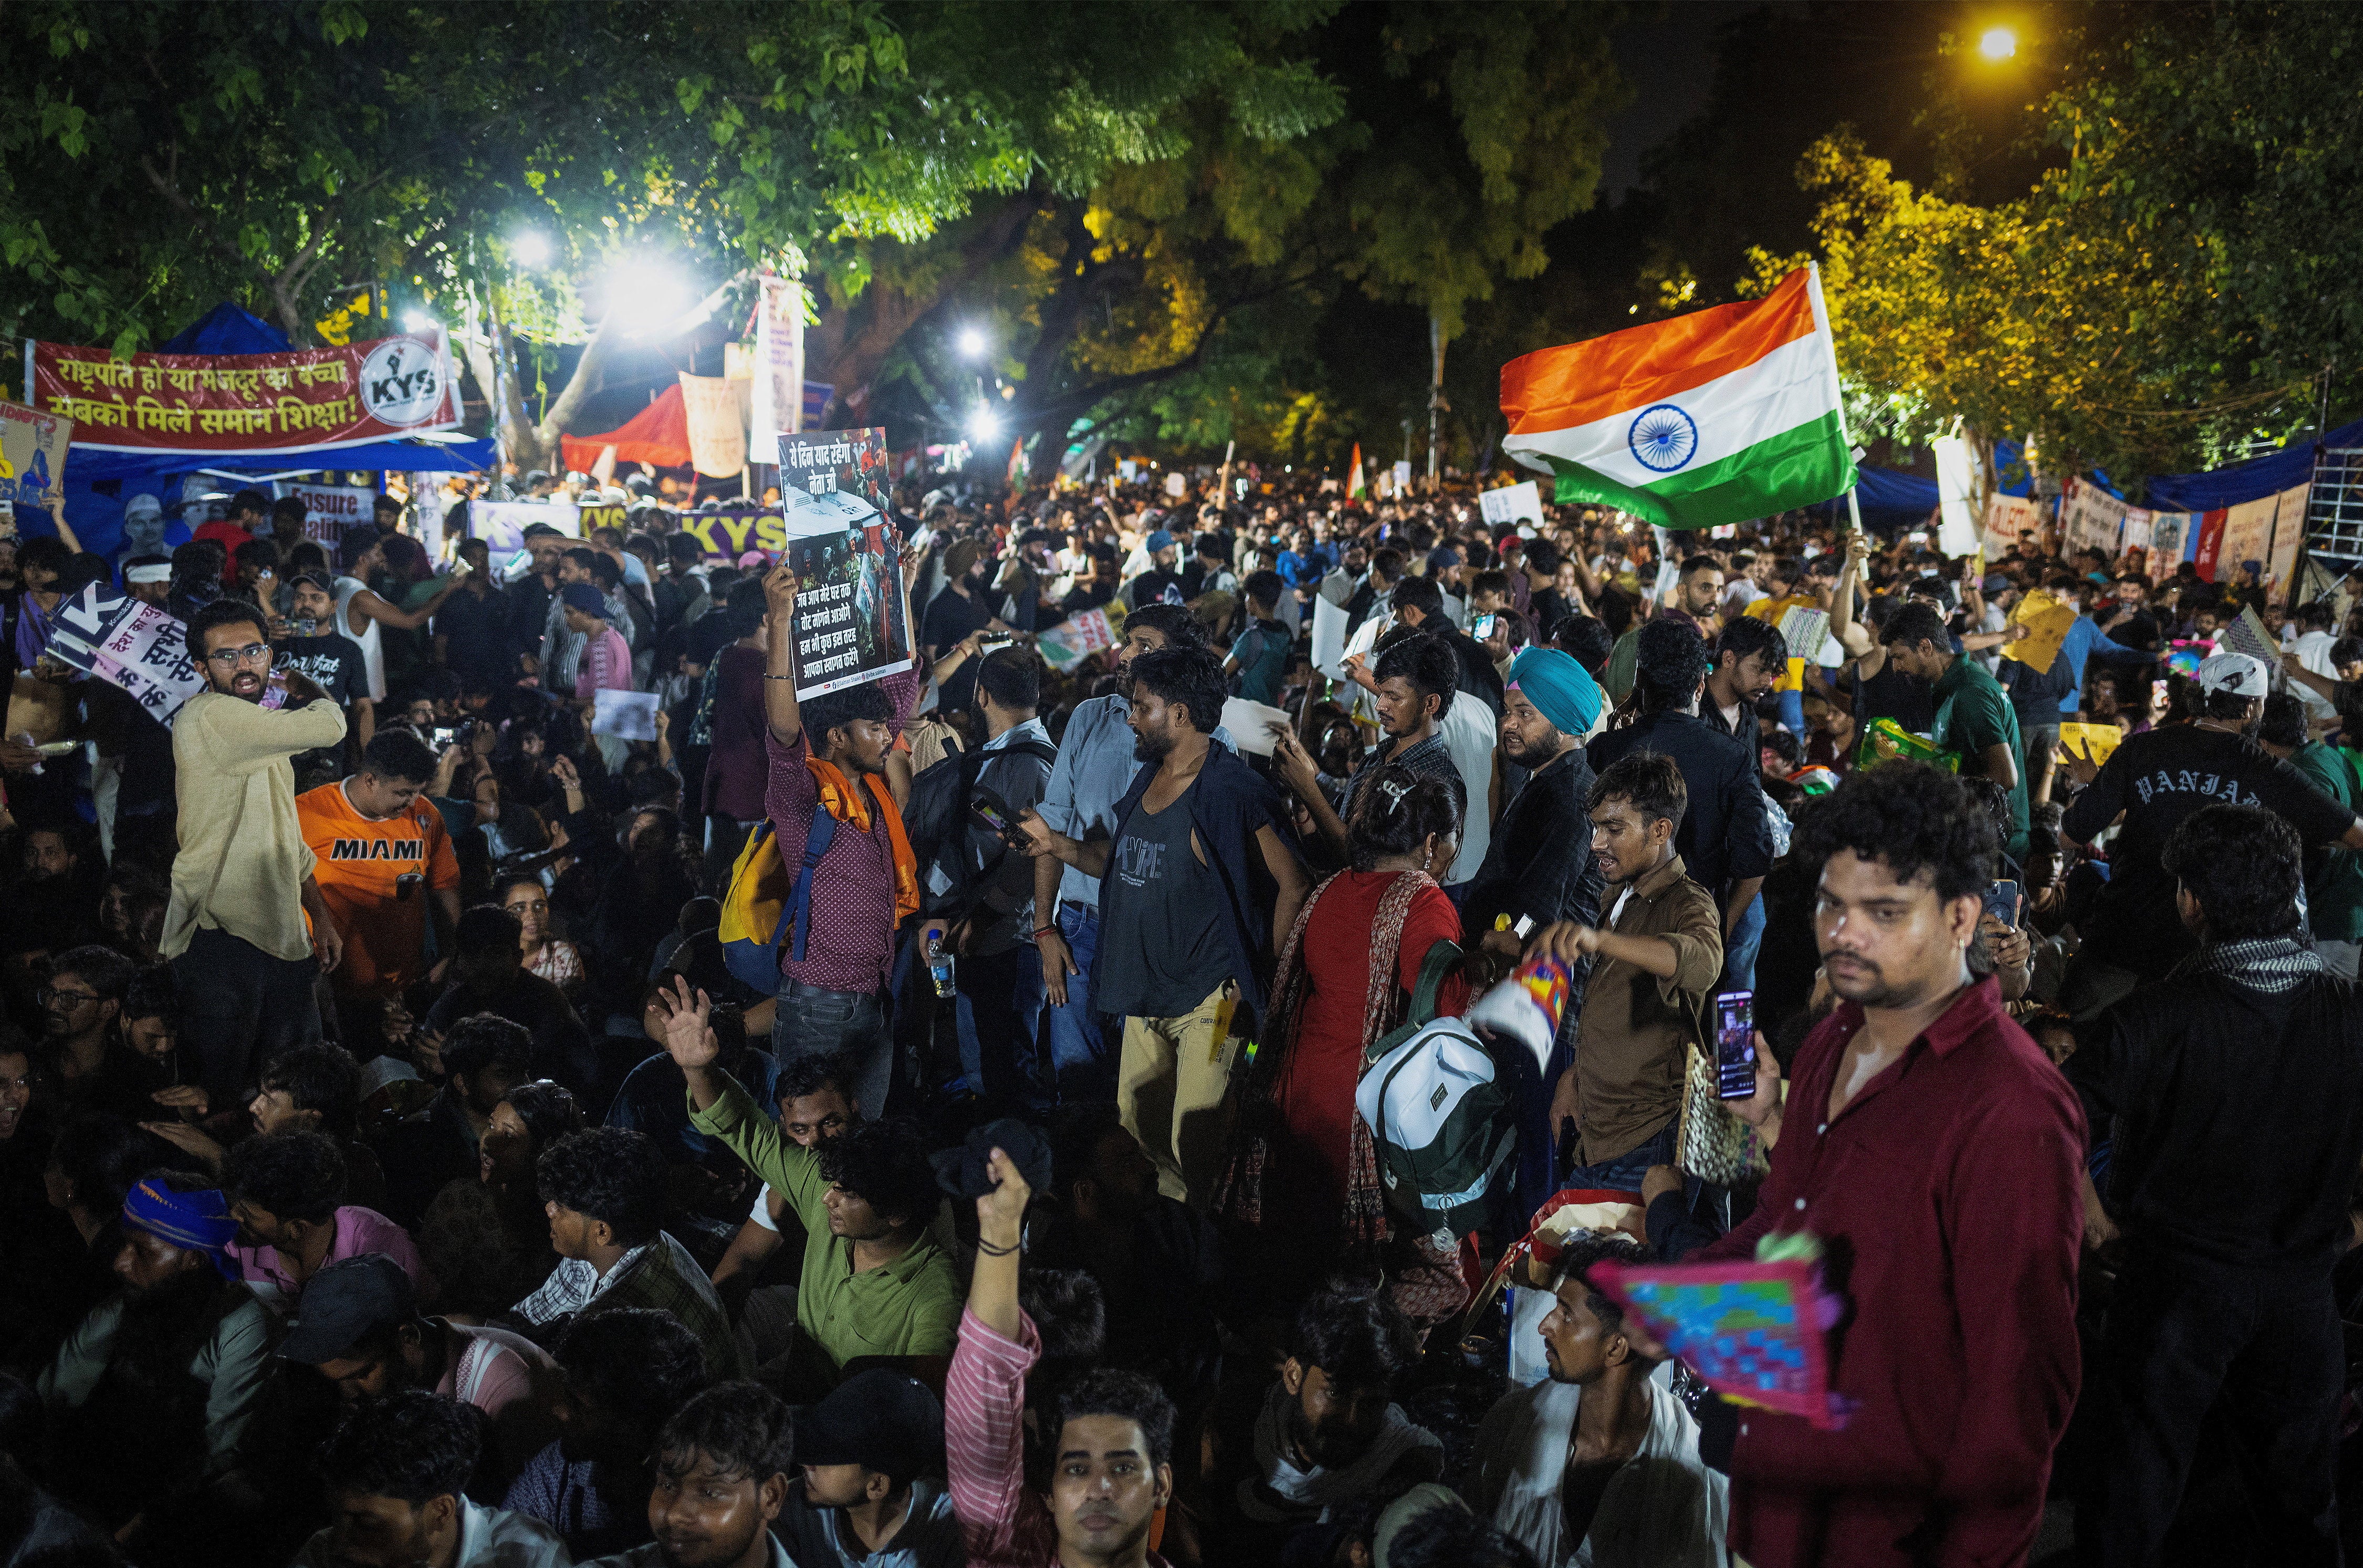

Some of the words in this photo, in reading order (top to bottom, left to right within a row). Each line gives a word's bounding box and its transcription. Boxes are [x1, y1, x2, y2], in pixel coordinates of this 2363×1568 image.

[56, 357, 135, 393] राष्ट्रपति
[139, 359, 164, 393] हो
[166, 369, 197, 392] या
[197, 369, 261, 401] मजदूर
[262, 367, 294, 391] का
[295, 360, 347, 387] बच्चा
[371, 369, 436, 404] KYS
[46, 393, 131, 427] सबको
[133, 396, 194, 433] मिले
[197, 409, 274, 434] समान
[276, 395, 358, 432] शिक्षा!
[789, 442, 798, 468] ये
[798, 441, 814, 468] दिन
[814, 445, 830, 466] याद
[830, 438, 851, 465] रहेगा
[808, 469, 825, 495] नेता
[825, 467, 837, 493] जी
[682, 516, 787, 553] KYS
[797, 592, 808, 608] जब
[808, 590, 819, 605] आप
[819, 583, 830, 602] मेरे
[830, 585, 840, 600] घर
[840, 582, 851, 598] तक
[800, 612, 812, 631] वोट
[812, 607, 830, 628] मांगने
[830, 602, 851, 623] आओगे
[799, 639, 811, 655] हम
[811, 633, 820, 652] भी
[820, 633, 832, 655] कुछ
[832, 631, 843, 649] इस
[843, 628, 856, 644] तरह
[803, 660, 823, 678] आपका
[823, 654, 843, 673] स्वागत
[843, 646, 859, 667] करेंगे
[330, 839, 424, 861] MIAMI
